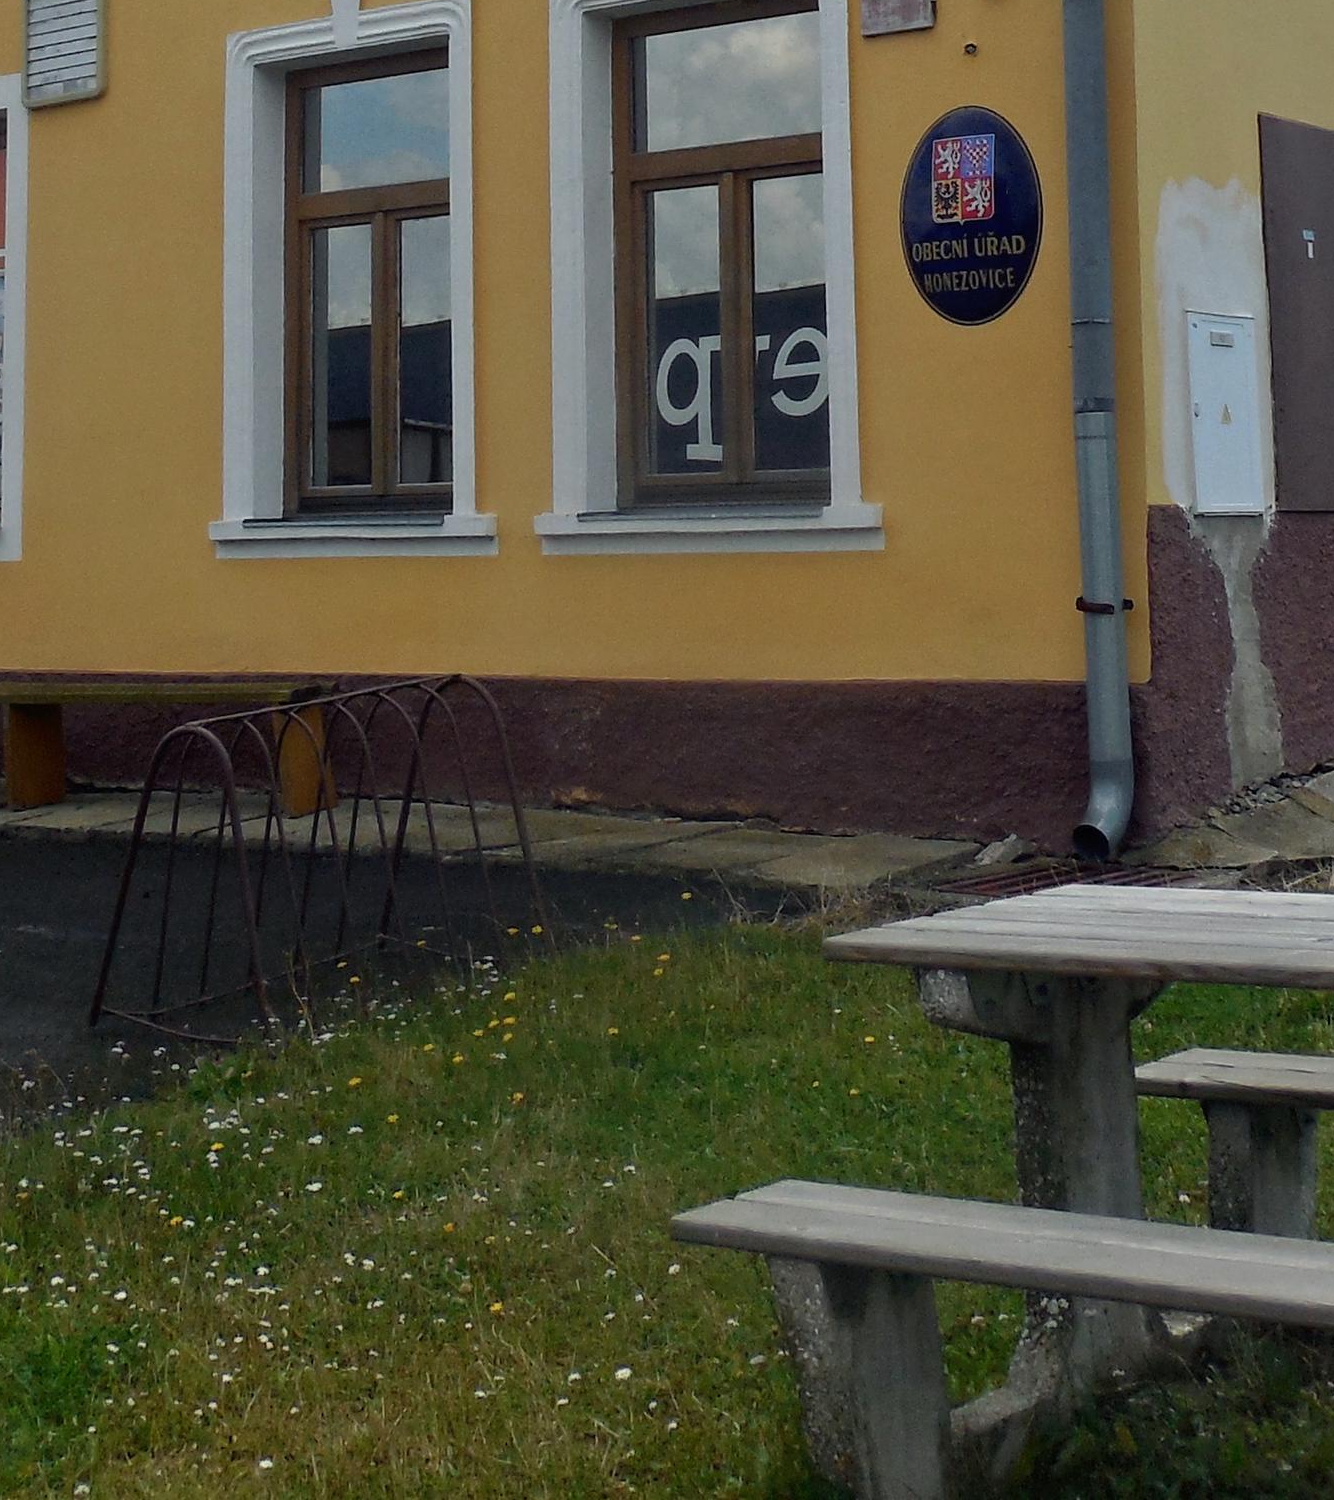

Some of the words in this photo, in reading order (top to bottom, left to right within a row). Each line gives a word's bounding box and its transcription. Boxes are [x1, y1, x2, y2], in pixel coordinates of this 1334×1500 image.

[912, 233, 968, 263] OBECNÍ
[974, 231, 1026, 257] ÚŘAD
[923, 267, 1016, 293] HONEZOVICE
